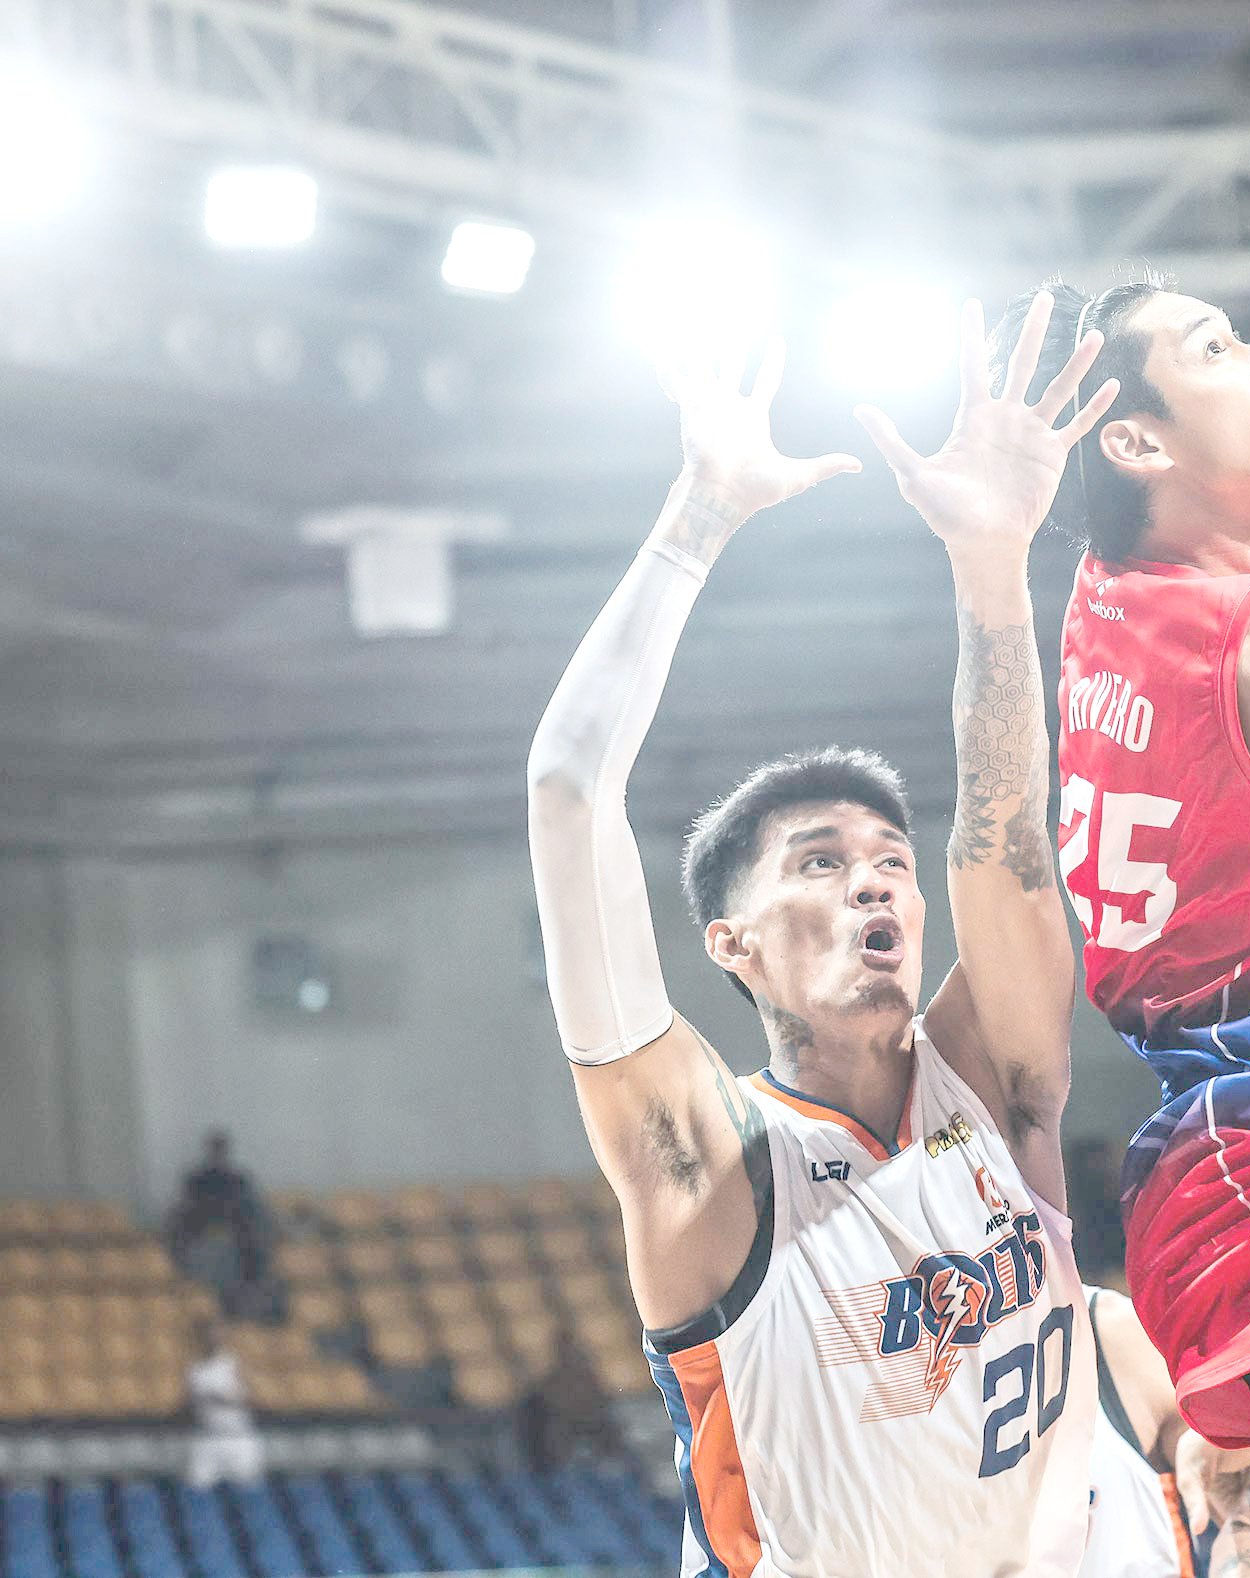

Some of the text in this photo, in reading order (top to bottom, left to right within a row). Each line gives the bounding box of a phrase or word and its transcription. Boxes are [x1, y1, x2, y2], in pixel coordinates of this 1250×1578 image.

[1068, 670, 1155, 753] RIVERO
[874, 1208, 1047, 1358] BOLTS
[978, 1303, 1074, 1479] 20
